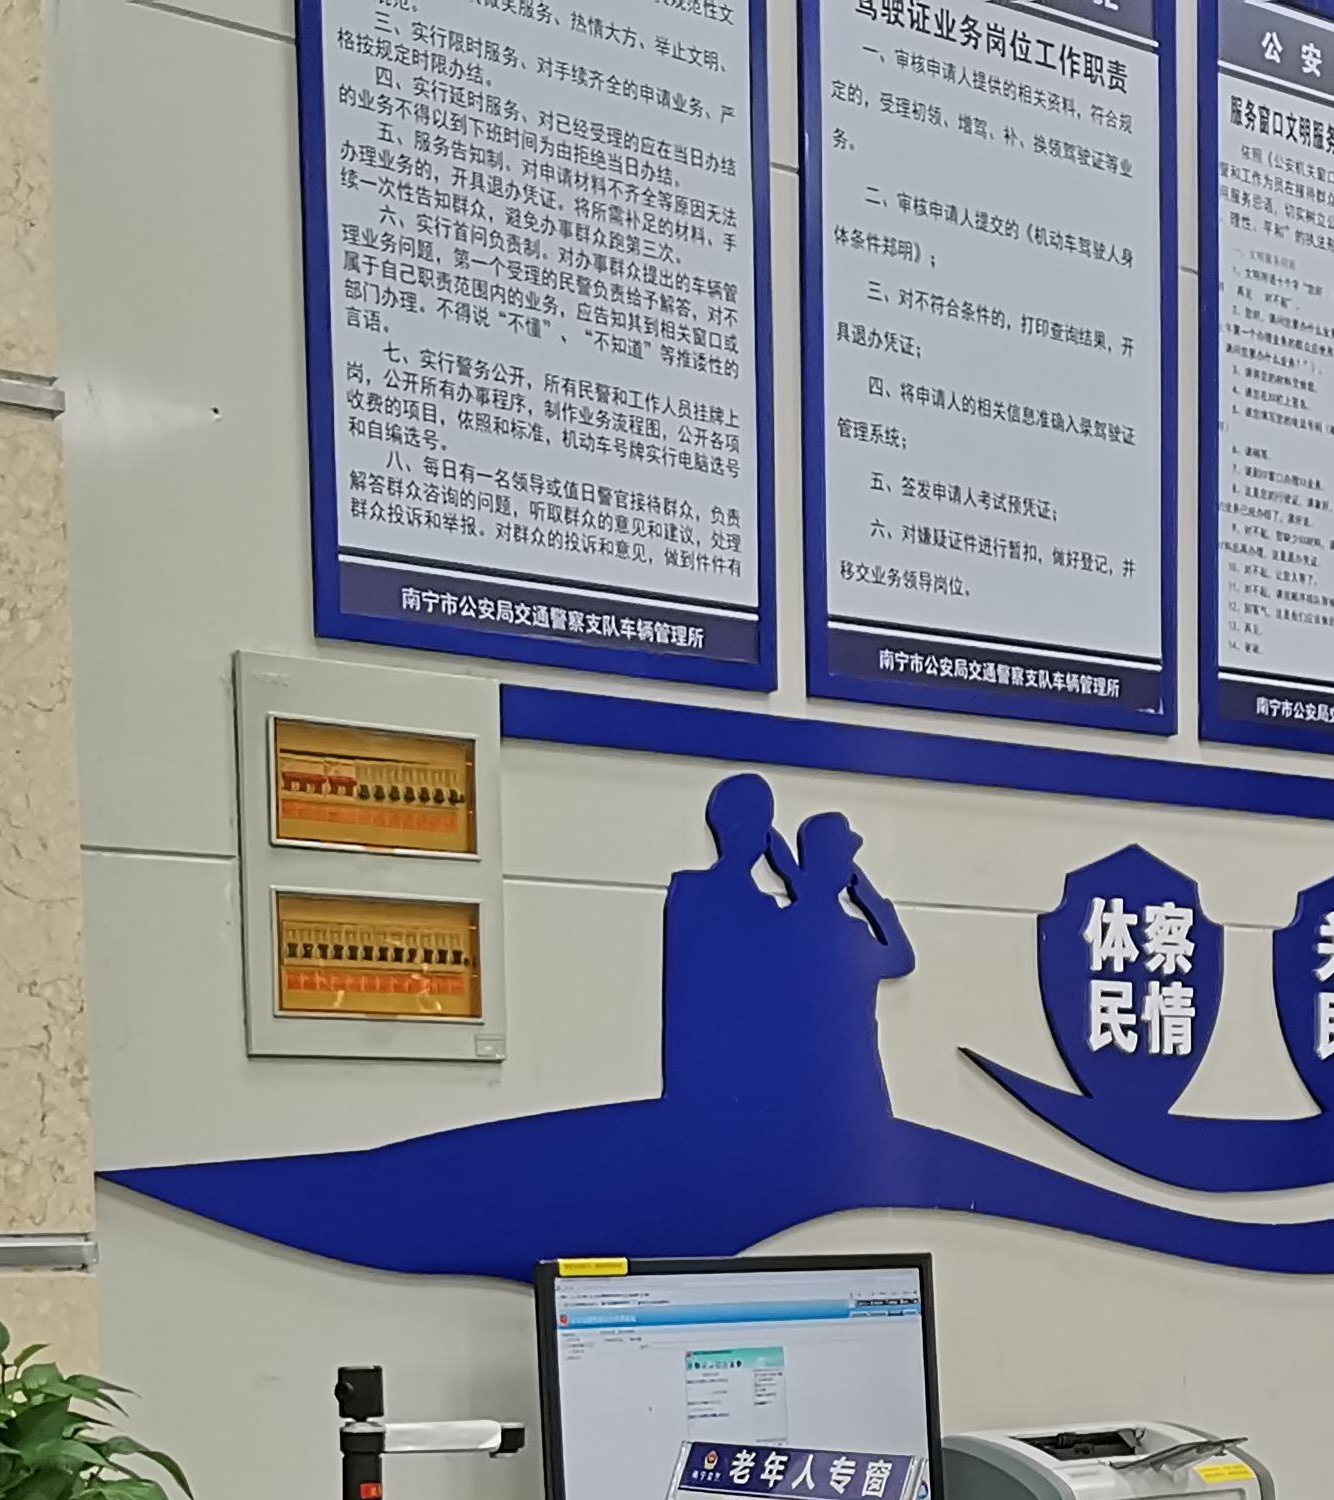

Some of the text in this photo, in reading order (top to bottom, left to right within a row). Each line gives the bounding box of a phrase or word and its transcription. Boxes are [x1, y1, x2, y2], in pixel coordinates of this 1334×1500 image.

[1261, 31, 1322, 77] 公安
[402, 586, 705, 649] 南宁市公安局交通警察支队车辆管理所
[1083, 897, 1196, 976] 体察
[1087, 980, 1196, 1055] 民情
[729, 1450, 892, 1497] 老年人专窗
